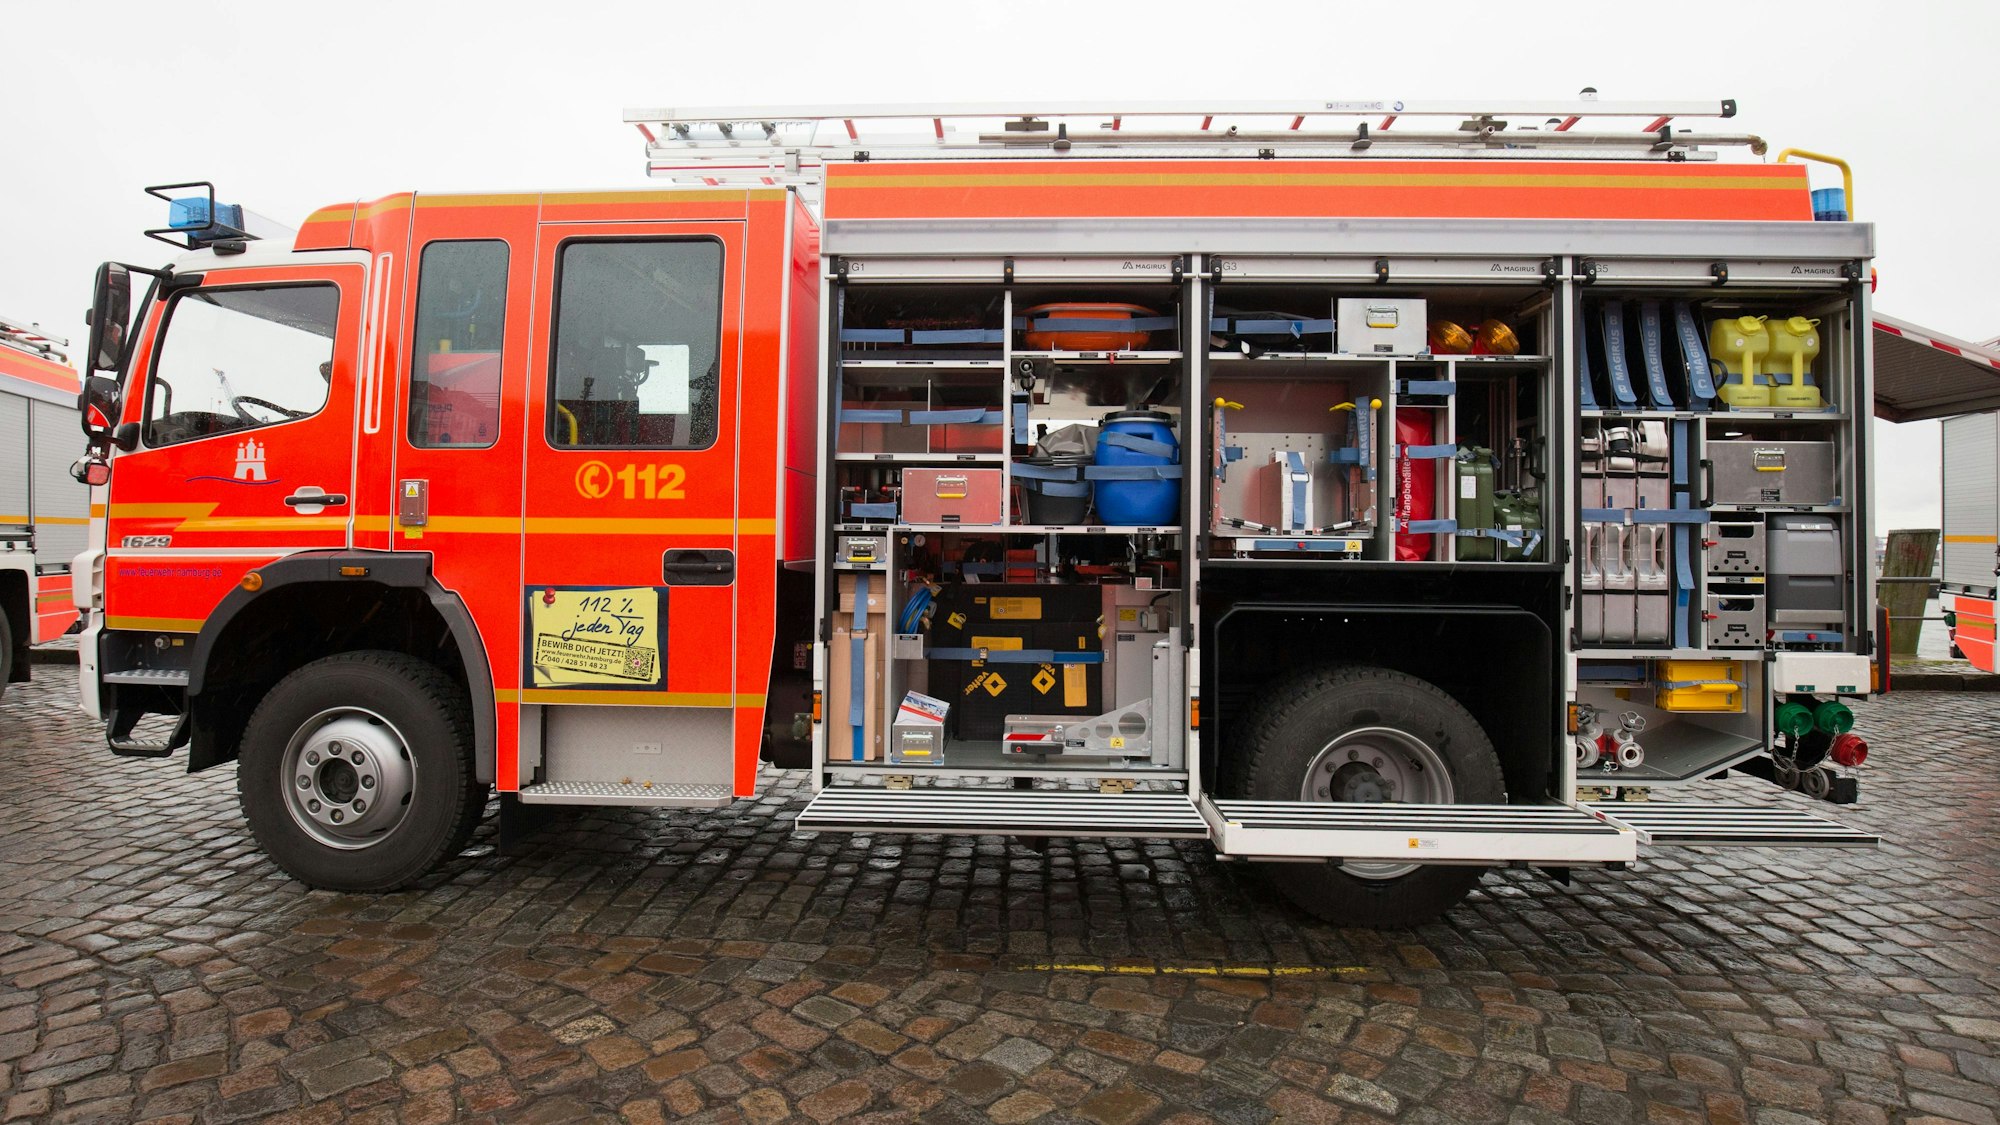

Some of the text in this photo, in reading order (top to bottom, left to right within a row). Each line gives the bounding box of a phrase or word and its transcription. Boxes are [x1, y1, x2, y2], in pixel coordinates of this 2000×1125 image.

[851, 262, 865, 272] G1
[1222, 261, 1238, 271] G3
[1611, 329, 1625, 381] MAGIRUS
[1647, 330, 1661, 383] MAGIRUS
[1684, 327, 1706, 375] MAGIRUS
[1358, 408, 1369, 460] MAGIRUS
[616, 463, 686, 499] 112
[121, 536, 171, 548] 1629
[579, 596, 634, 614] 112 %
[561, 613, 645, 648] jeden Tag
[541, 639, 625, 658] BEWIRB DICH JETZT!
[541, 649, 622, 665] www.feuerwehr.hamburg.de
[547, 655, 560, 664] 040
[565, 658, 578, 666] 428
